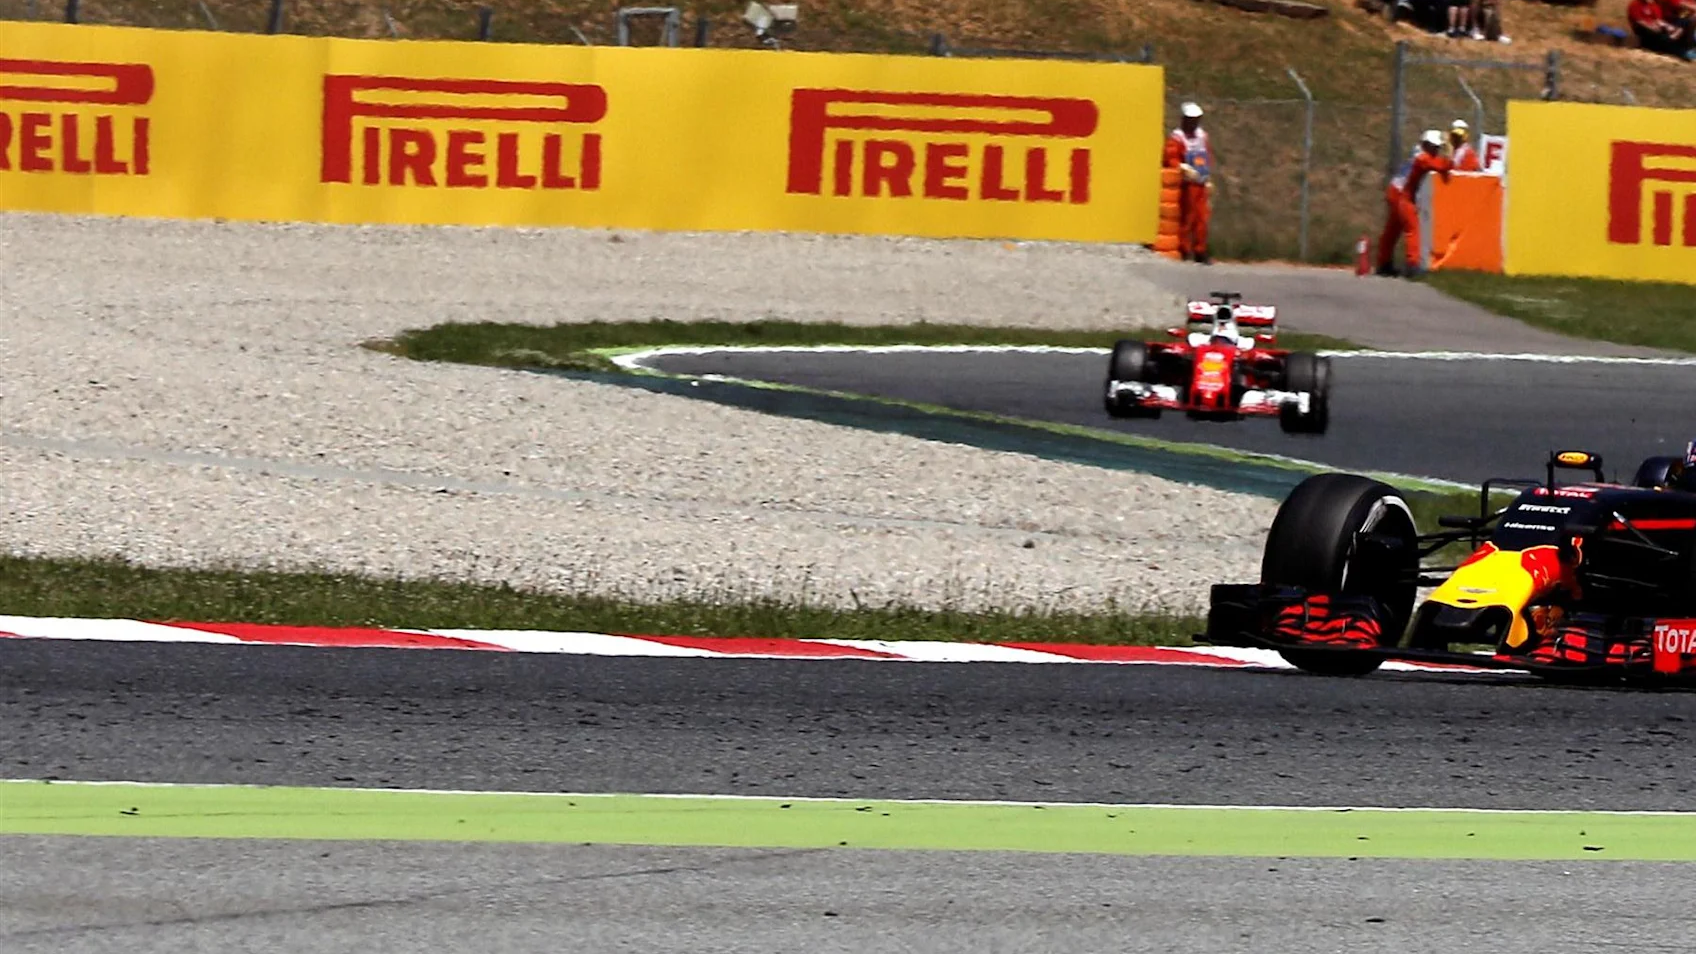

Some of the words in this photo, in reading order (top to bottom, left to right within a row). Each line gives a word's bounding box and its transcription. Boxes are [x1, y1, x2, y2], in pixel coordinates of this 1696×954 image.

[321, 75, 607, 189] PIRELLI
[786, 89, 1098, 203] PIRELLI
[1485, 142, 1503, 169] F
